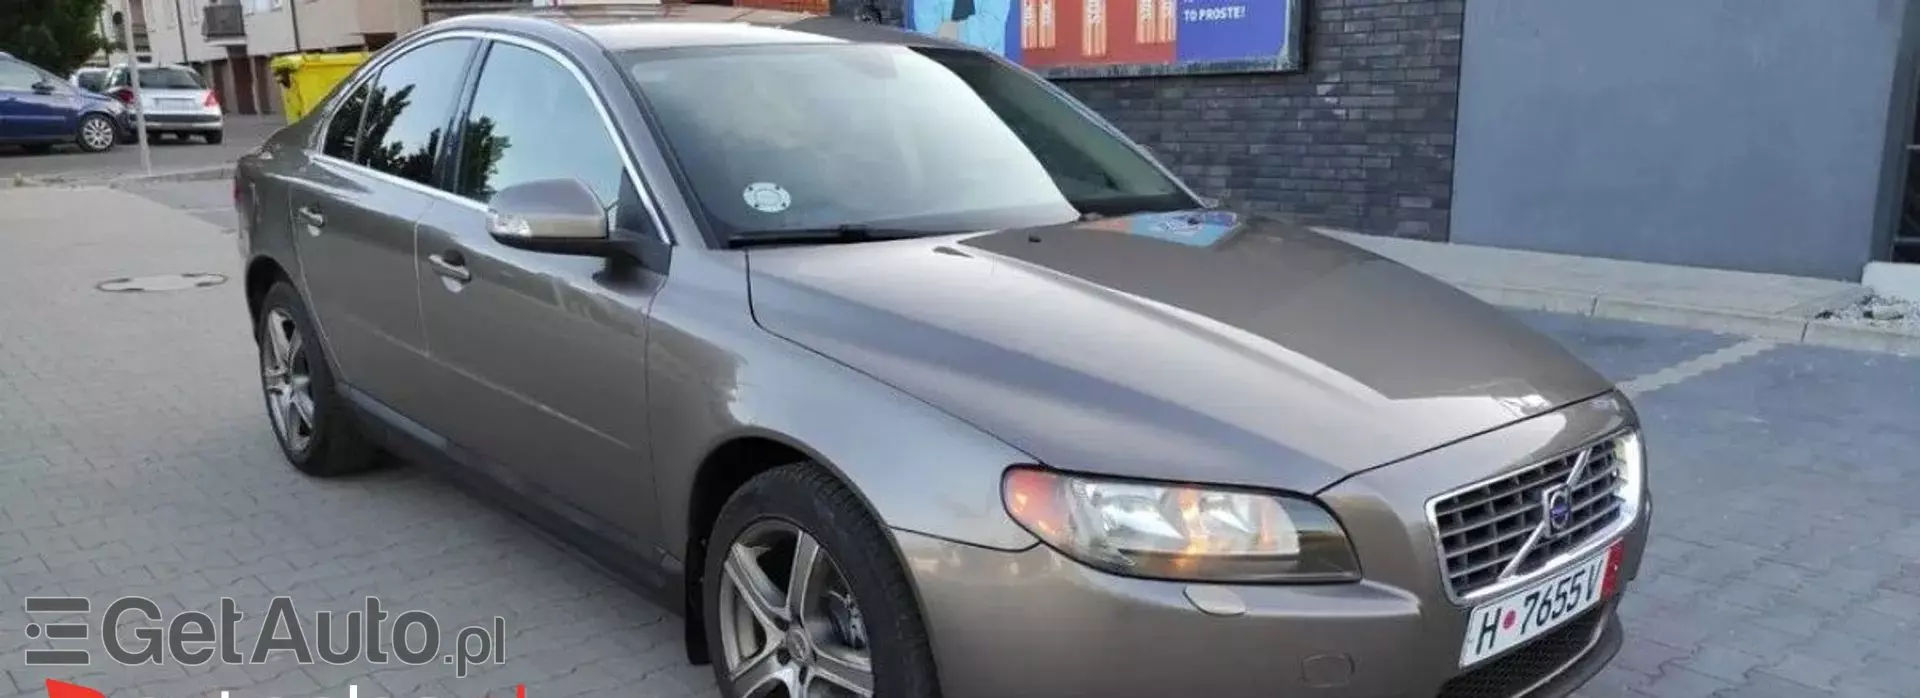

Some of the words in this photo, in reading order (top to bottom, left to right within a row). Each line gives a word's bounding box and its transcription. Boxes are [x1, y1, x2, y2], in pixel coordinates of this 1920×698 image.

[1184, 9, 1198, 21] TO
[1199, 6, 1246, 20] PROSTE!
[1476, 608, 1502, 655] H
[1521, 562, 1602, 634] 7655V
